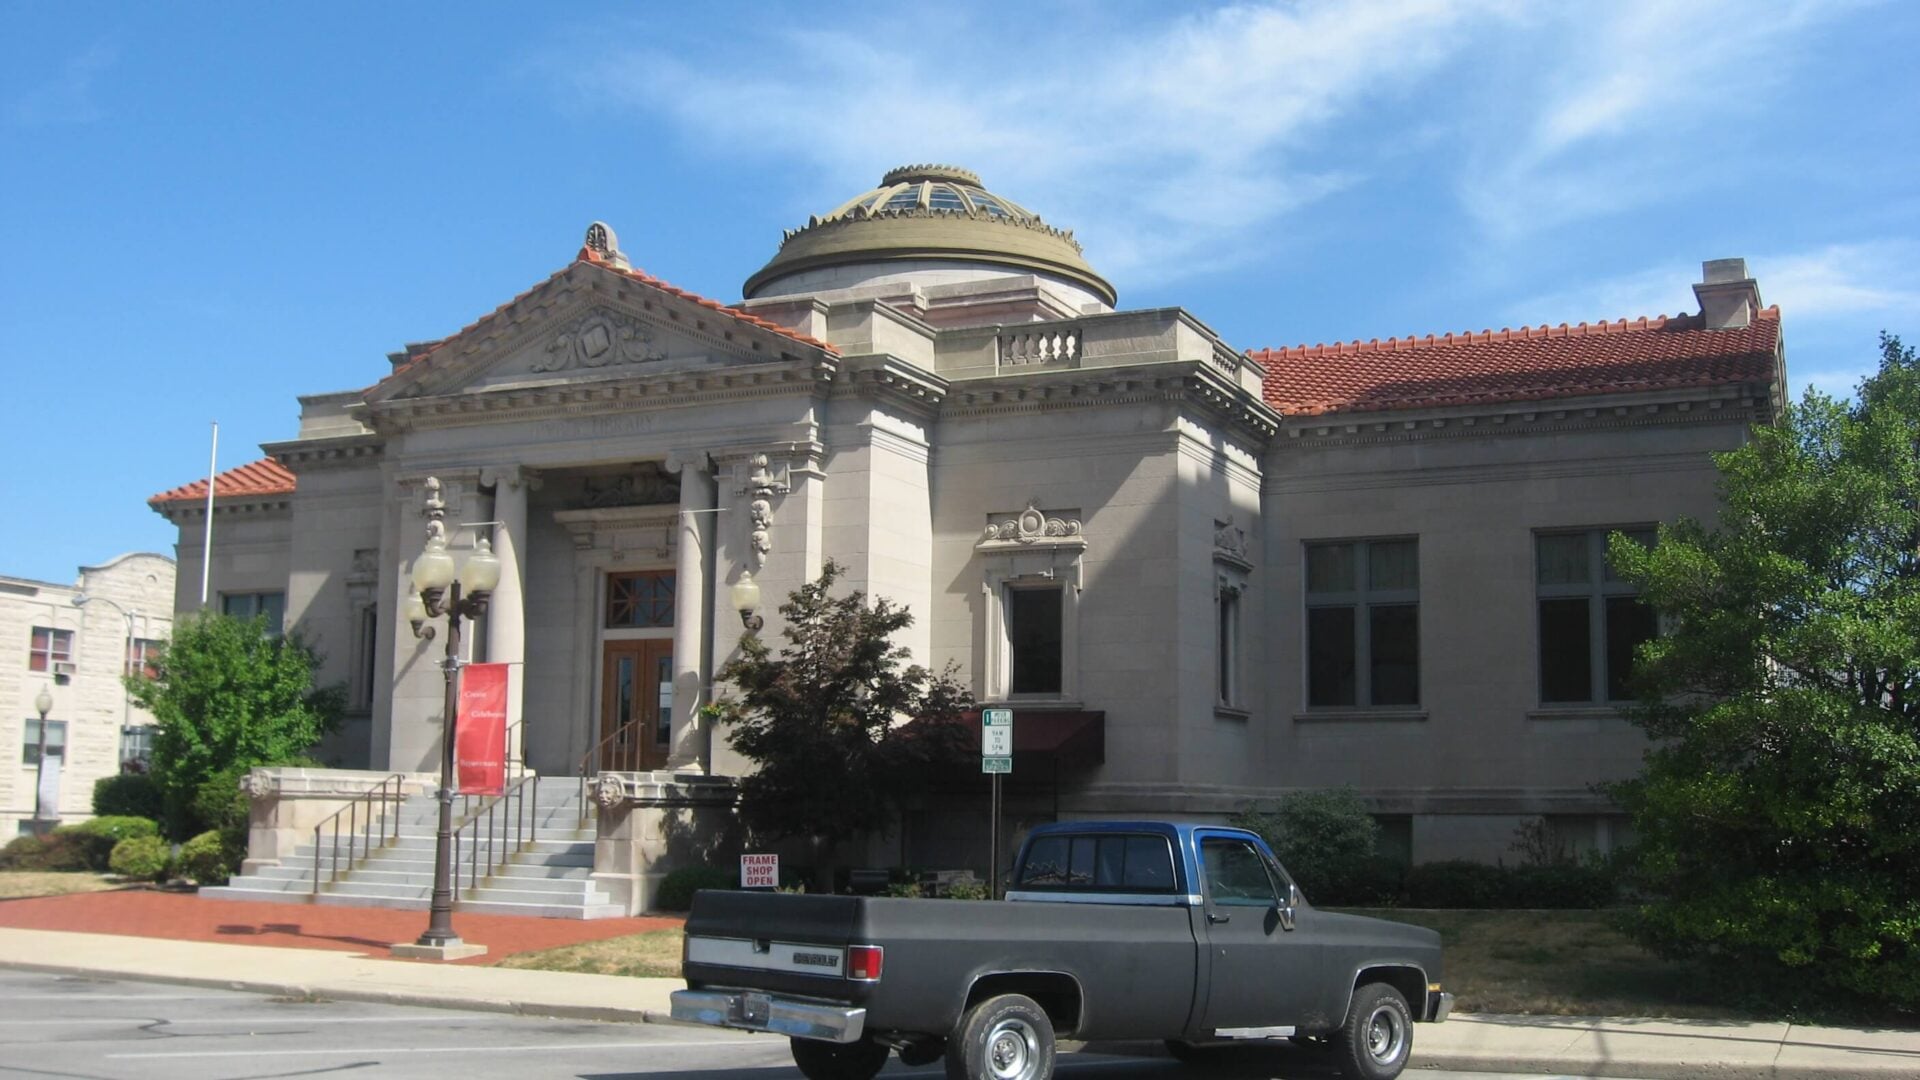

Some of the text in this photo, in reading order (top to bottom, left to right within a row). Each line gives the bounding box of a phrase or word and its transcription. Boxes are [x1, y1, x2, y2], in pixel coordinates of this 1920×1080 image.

[743, 856, 776, 864] FRAME
[746, 866, 773, 875] SHOP
[747, 877, 773, 885] OPEN
